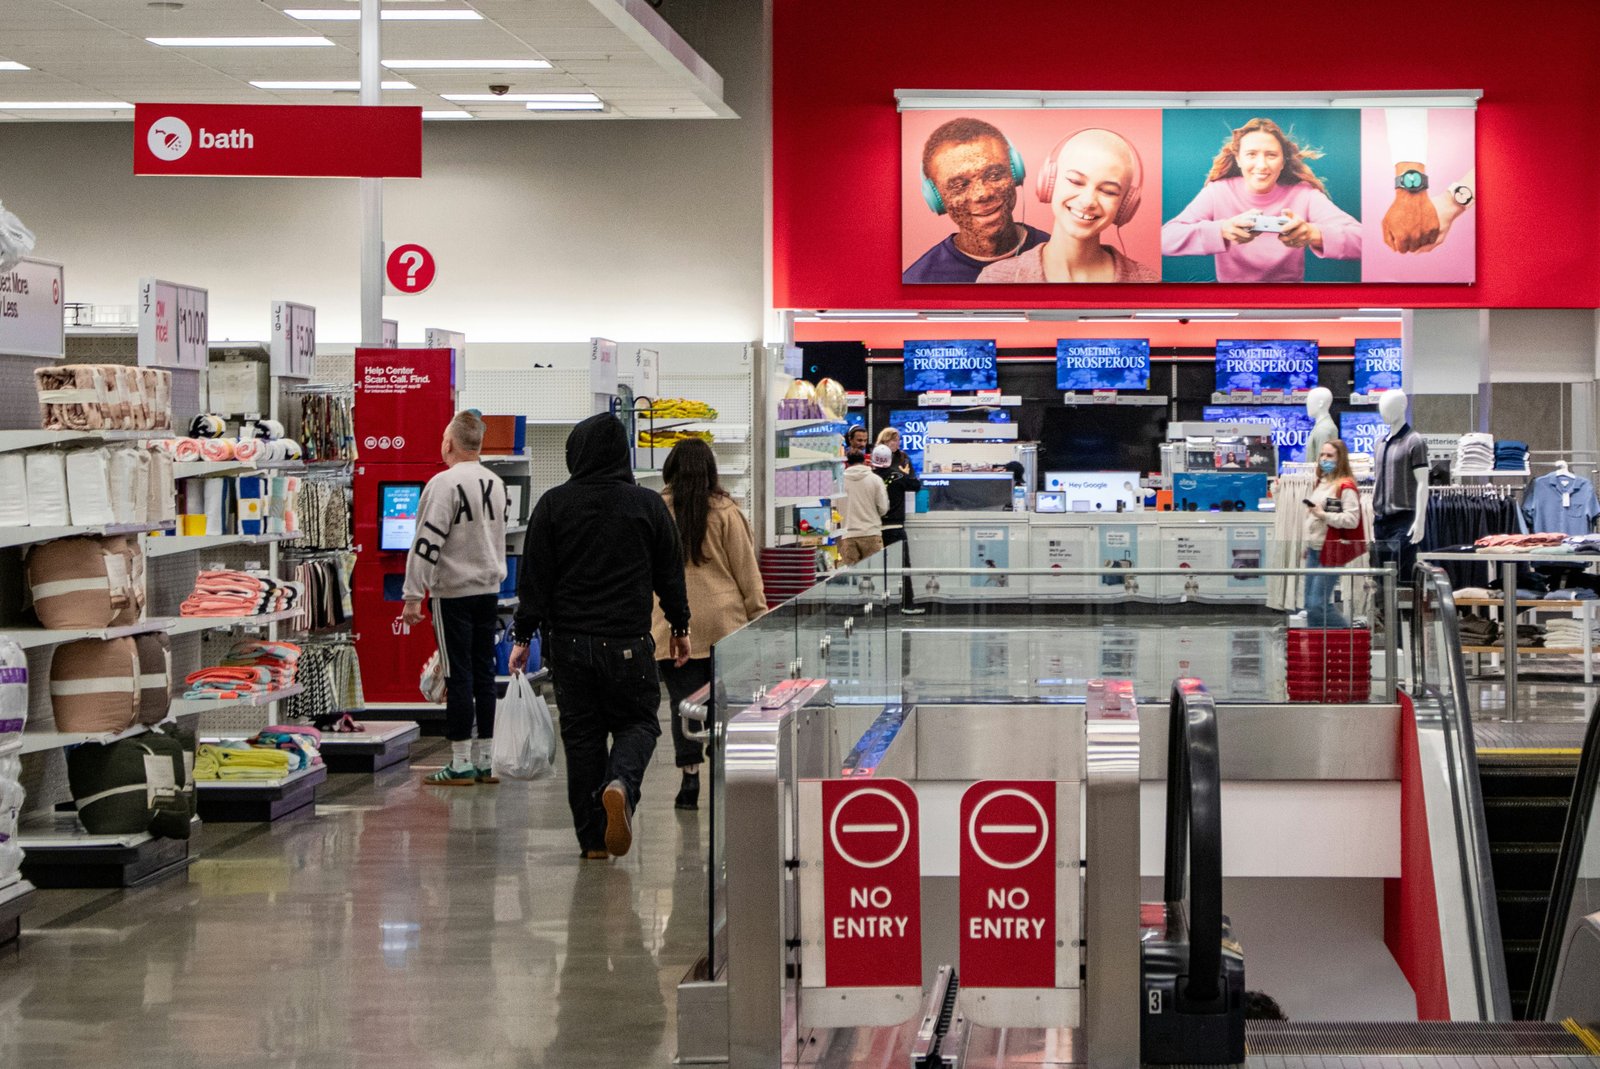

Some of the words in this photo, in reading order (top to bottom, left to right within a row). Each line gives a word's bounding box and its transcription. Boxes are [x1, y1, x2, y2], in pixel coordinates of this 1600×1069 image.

[198, 128, 254, 149] bath
[915, 348, 968, 357] SOMETHING
[1068, 347, 1121, 356] SOMETHING
[1228, 348, 1287, 359] SOMETHING
[913, 356, 993, 370] PROSPEROUS
[1066, 356, 1146, 369] PROSPEROUS
[1226, 359, 1314, 373] PROSPEROUS
[364, 366, 385, 375] Help
[385, 366, 415, 375] Center
[364, 375, 389, 384] Scan.
[389, 375, 409, 384] Call.
[409, 375, 431, 384] Find.
[1068, 481, 1082, 489] Hey
[1083, 481, 1108, 490] Google
[851, 887, 892, 909] NO
[988, 887, 1030, 910] NO
[833, 917, 909, 939] ENTRY
[969, 917, 1046, 940] ENTRY
[1151, 991, 1160, 1012] 3
